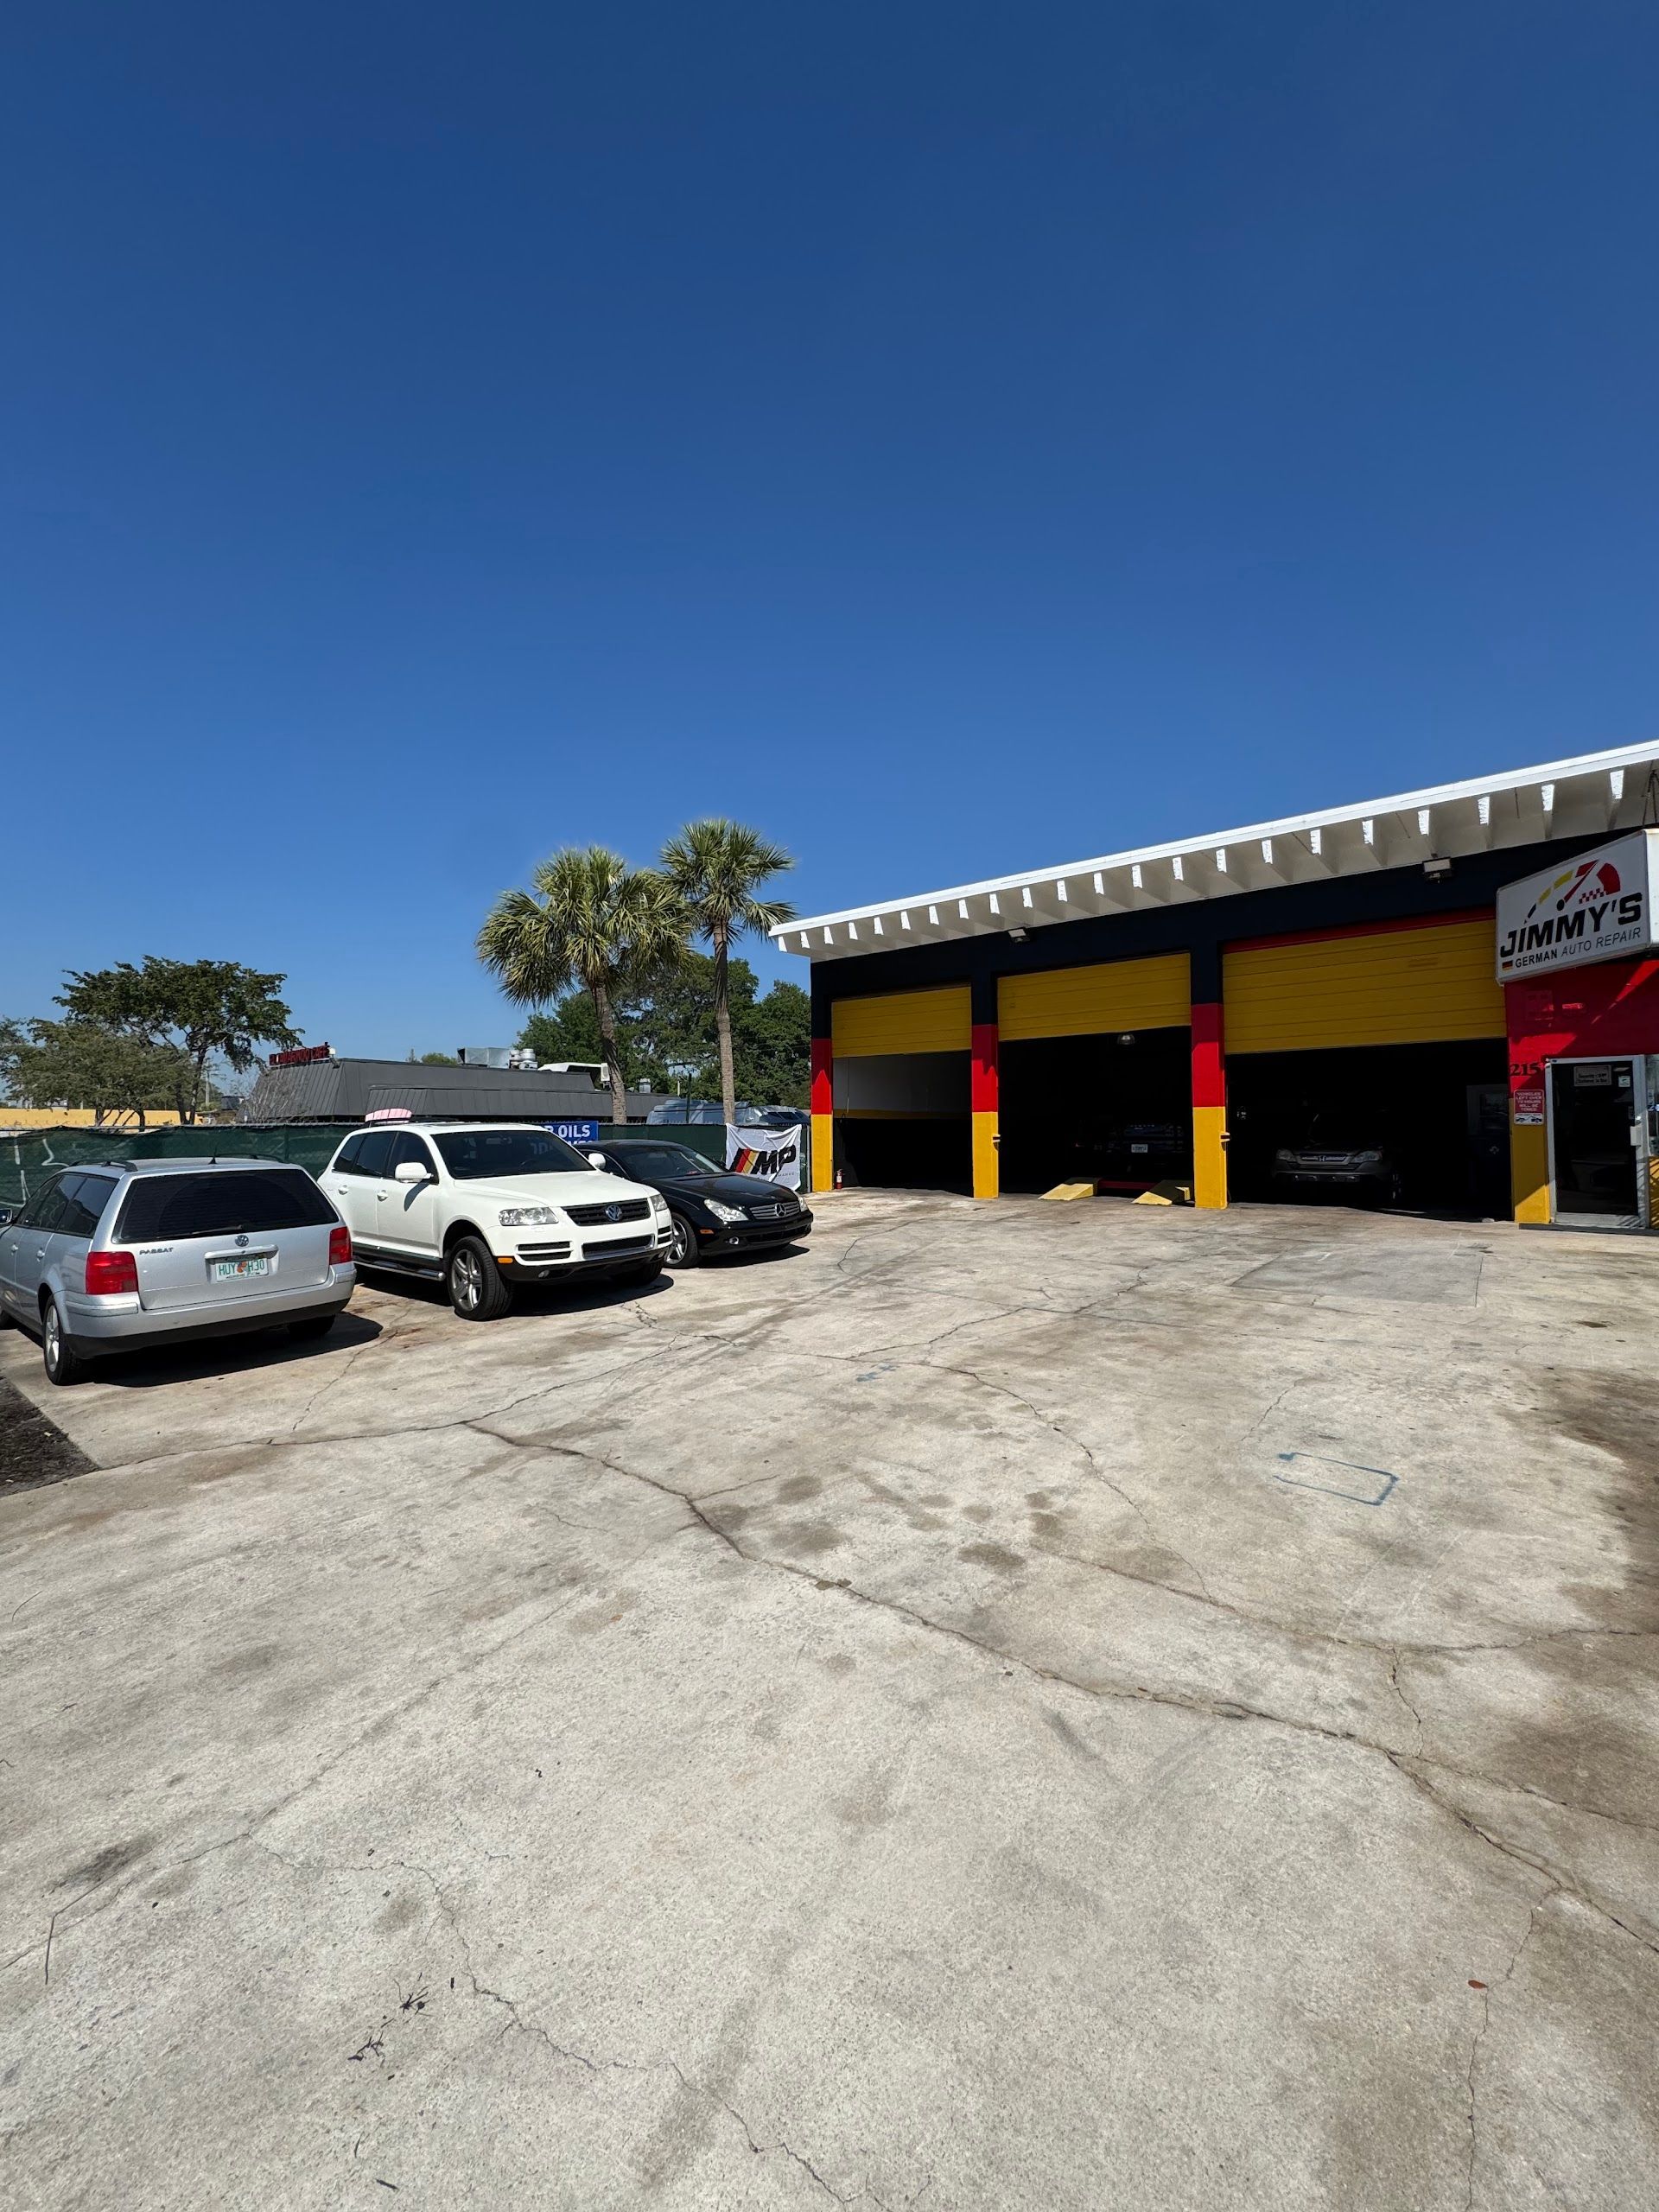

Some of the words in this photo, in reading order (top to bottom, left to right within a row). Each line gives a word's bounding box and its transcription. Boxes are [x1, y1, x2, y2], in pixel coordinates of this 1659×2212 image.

[1500, 892, 1643, 958] JIMMY'S
[1515, 950, 1558, 968] GERMAN
[1560, 940, 1592, 958] AUTO
[1596, 926, 1641, 949] REPAIR
[1510, 1061, 1541, 1077] 215
[557, 1124, 591, 1139] OILS
[139, 1247, 174, 1255] PASSAT
